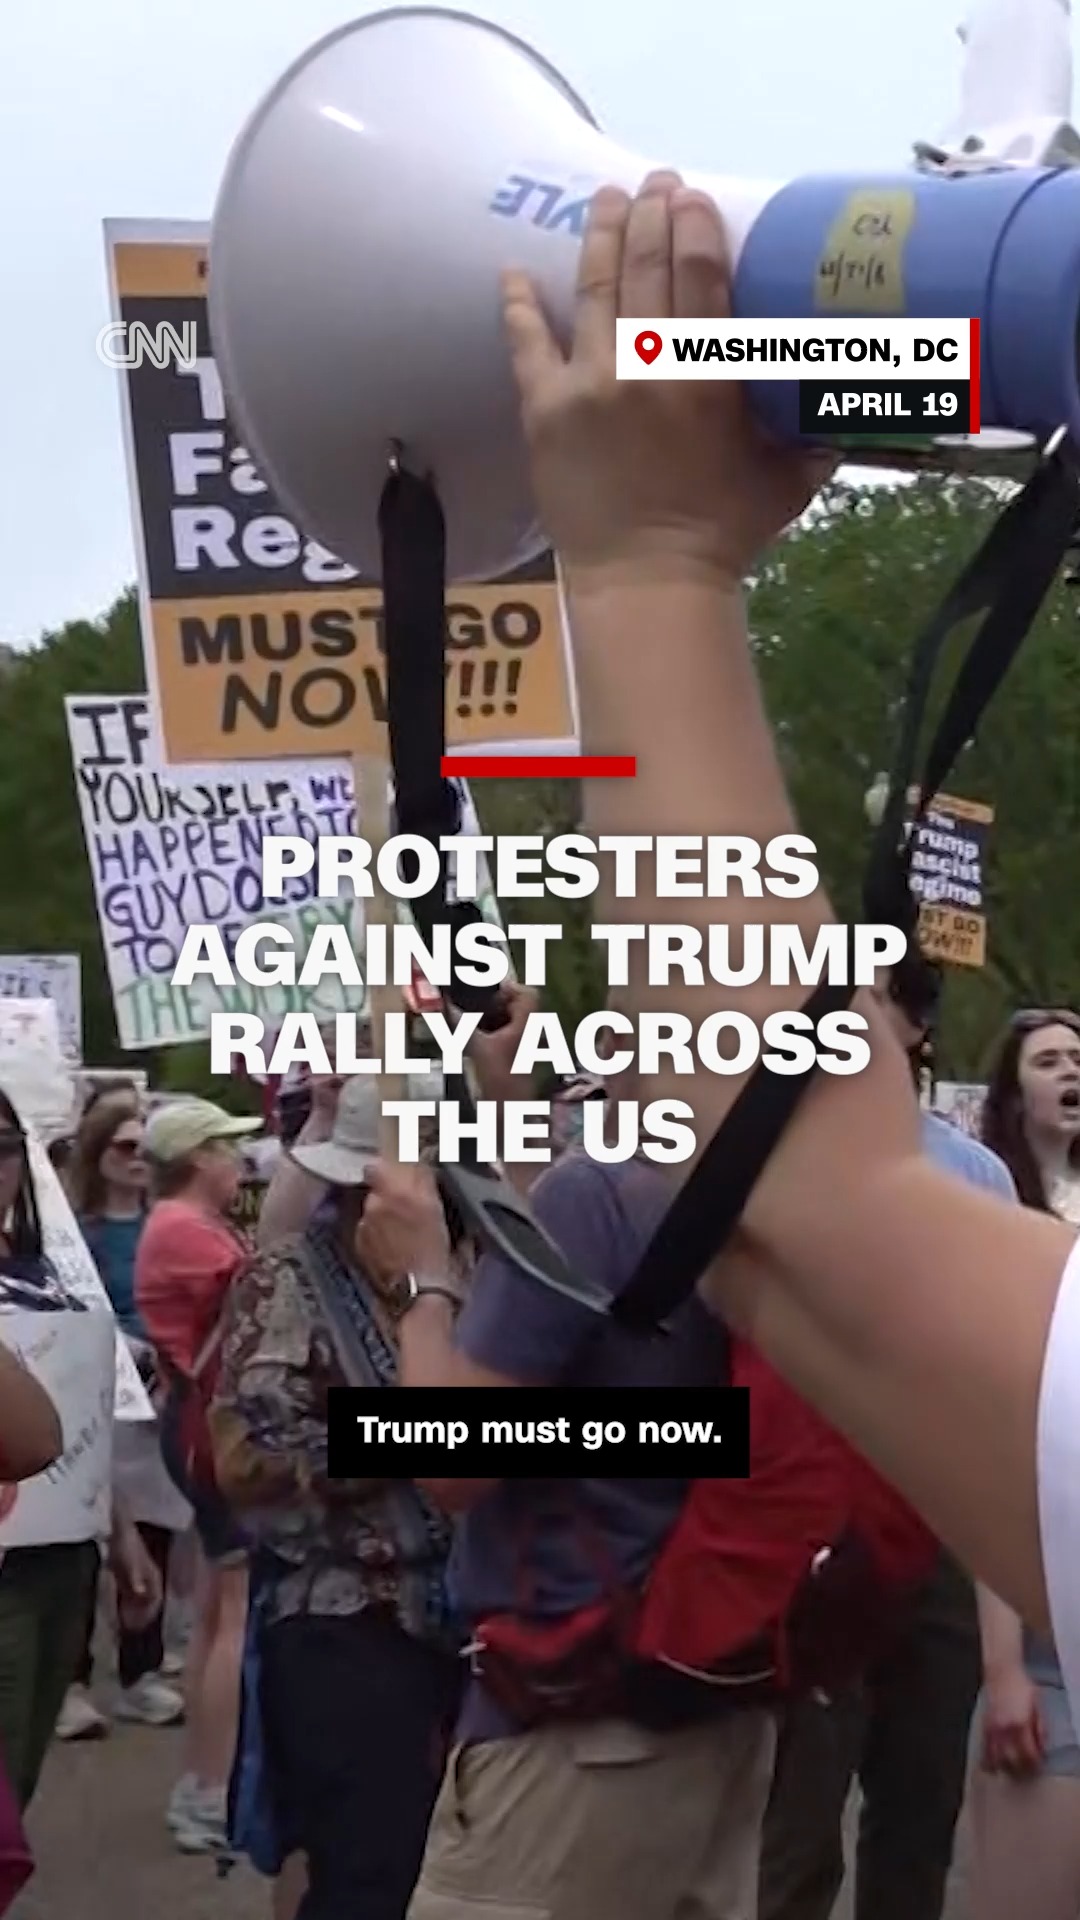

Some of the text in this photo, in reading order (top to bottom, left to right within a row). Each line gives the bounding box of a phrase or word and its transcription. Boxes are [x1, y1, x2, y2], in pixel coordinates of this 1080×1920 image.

[488, 173, 590, 237] YLE
[169, 432, 269, 496] Fa
[170, 505, 361, 583] Reg
[445, 602, 541, 650] GO
[72, 701, 148, 765] IF
